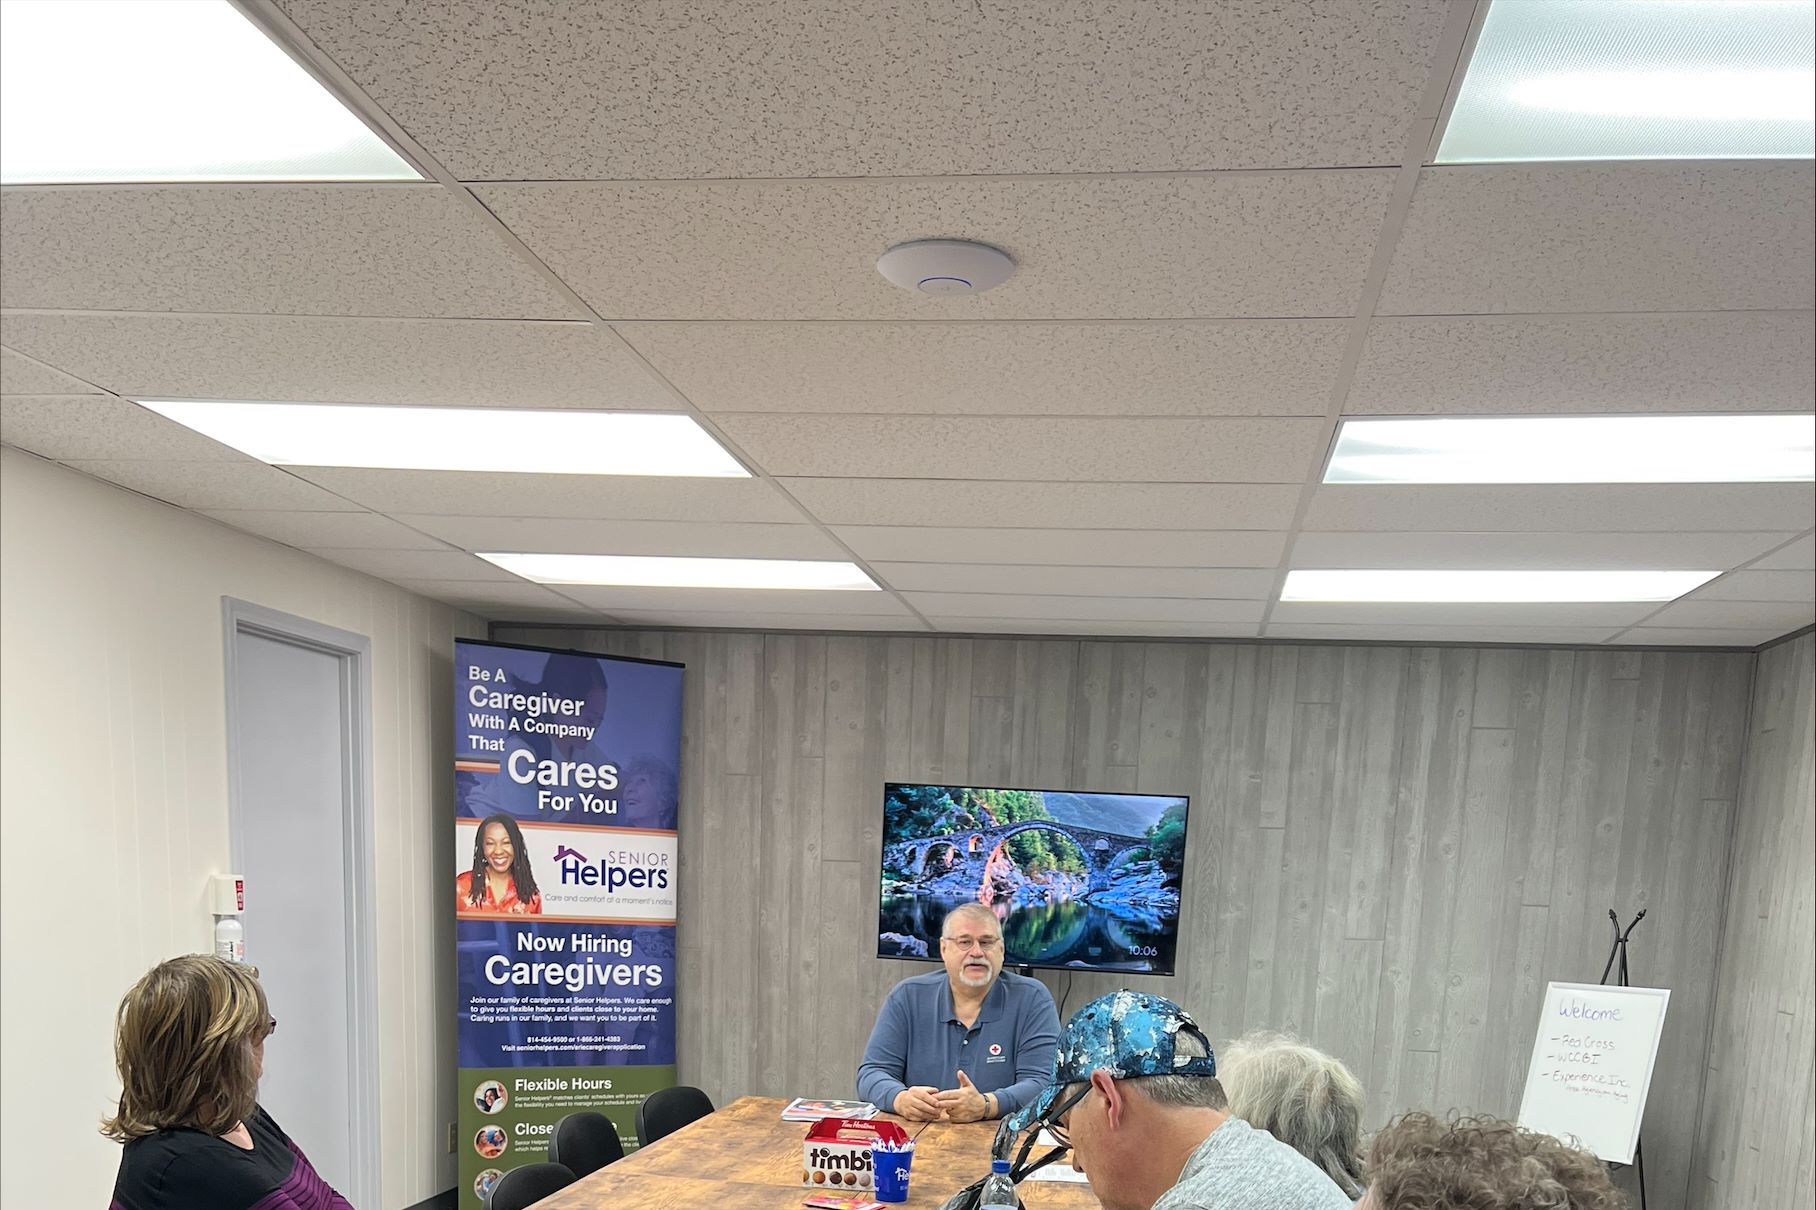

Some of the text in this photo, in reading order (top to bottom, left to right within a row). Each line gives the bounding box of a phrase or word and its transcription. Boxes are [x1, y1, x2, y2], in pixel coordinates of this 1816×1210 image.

[468, 665, 507, 683] Be A
[468, 684, 585, 717] Caregiver
[468, 713, 595, 741] With A Company
[468, 735, 505, 752] That
[507, 749, 619, 791] Cares
[538, 790, 618, 815] For You
[608, 850, 669, 867] SENIOR
[561, 859, 668, 894] Helpers
[544, 893, 562, 902] Care
[564, 894, 578, 902] and
[580, 895, 606, 903] comfort
[517, 932, 633, 957] Now Hiring
[1128, 945, 1158, 957] 10:06
[484, 954, 663, 992] Caregivers
[470, 996, 486, 1004] Join
[500, 996, 520, 1005] family
[521, 996, 529, 1004] of
[529, 996, 564, 1005] caregivers
[596, 996, 622, 1005] Helpers.
[1560, 998, 1623, 1020] Welcome
[470, 1014, 494, 1023] Caring
[531, 1014, 553, 1022] family,
[480, 1006, 494, 1014] give
[1584, 1035, 1616, 1050] Cross
[514, 1077, 612, 1092] Flexible Hours
[1552, 1069, 1607, 1084] Experience
[514, 1122, 554, 1135] Close
[810, 1148, 872, 1171] timbi
